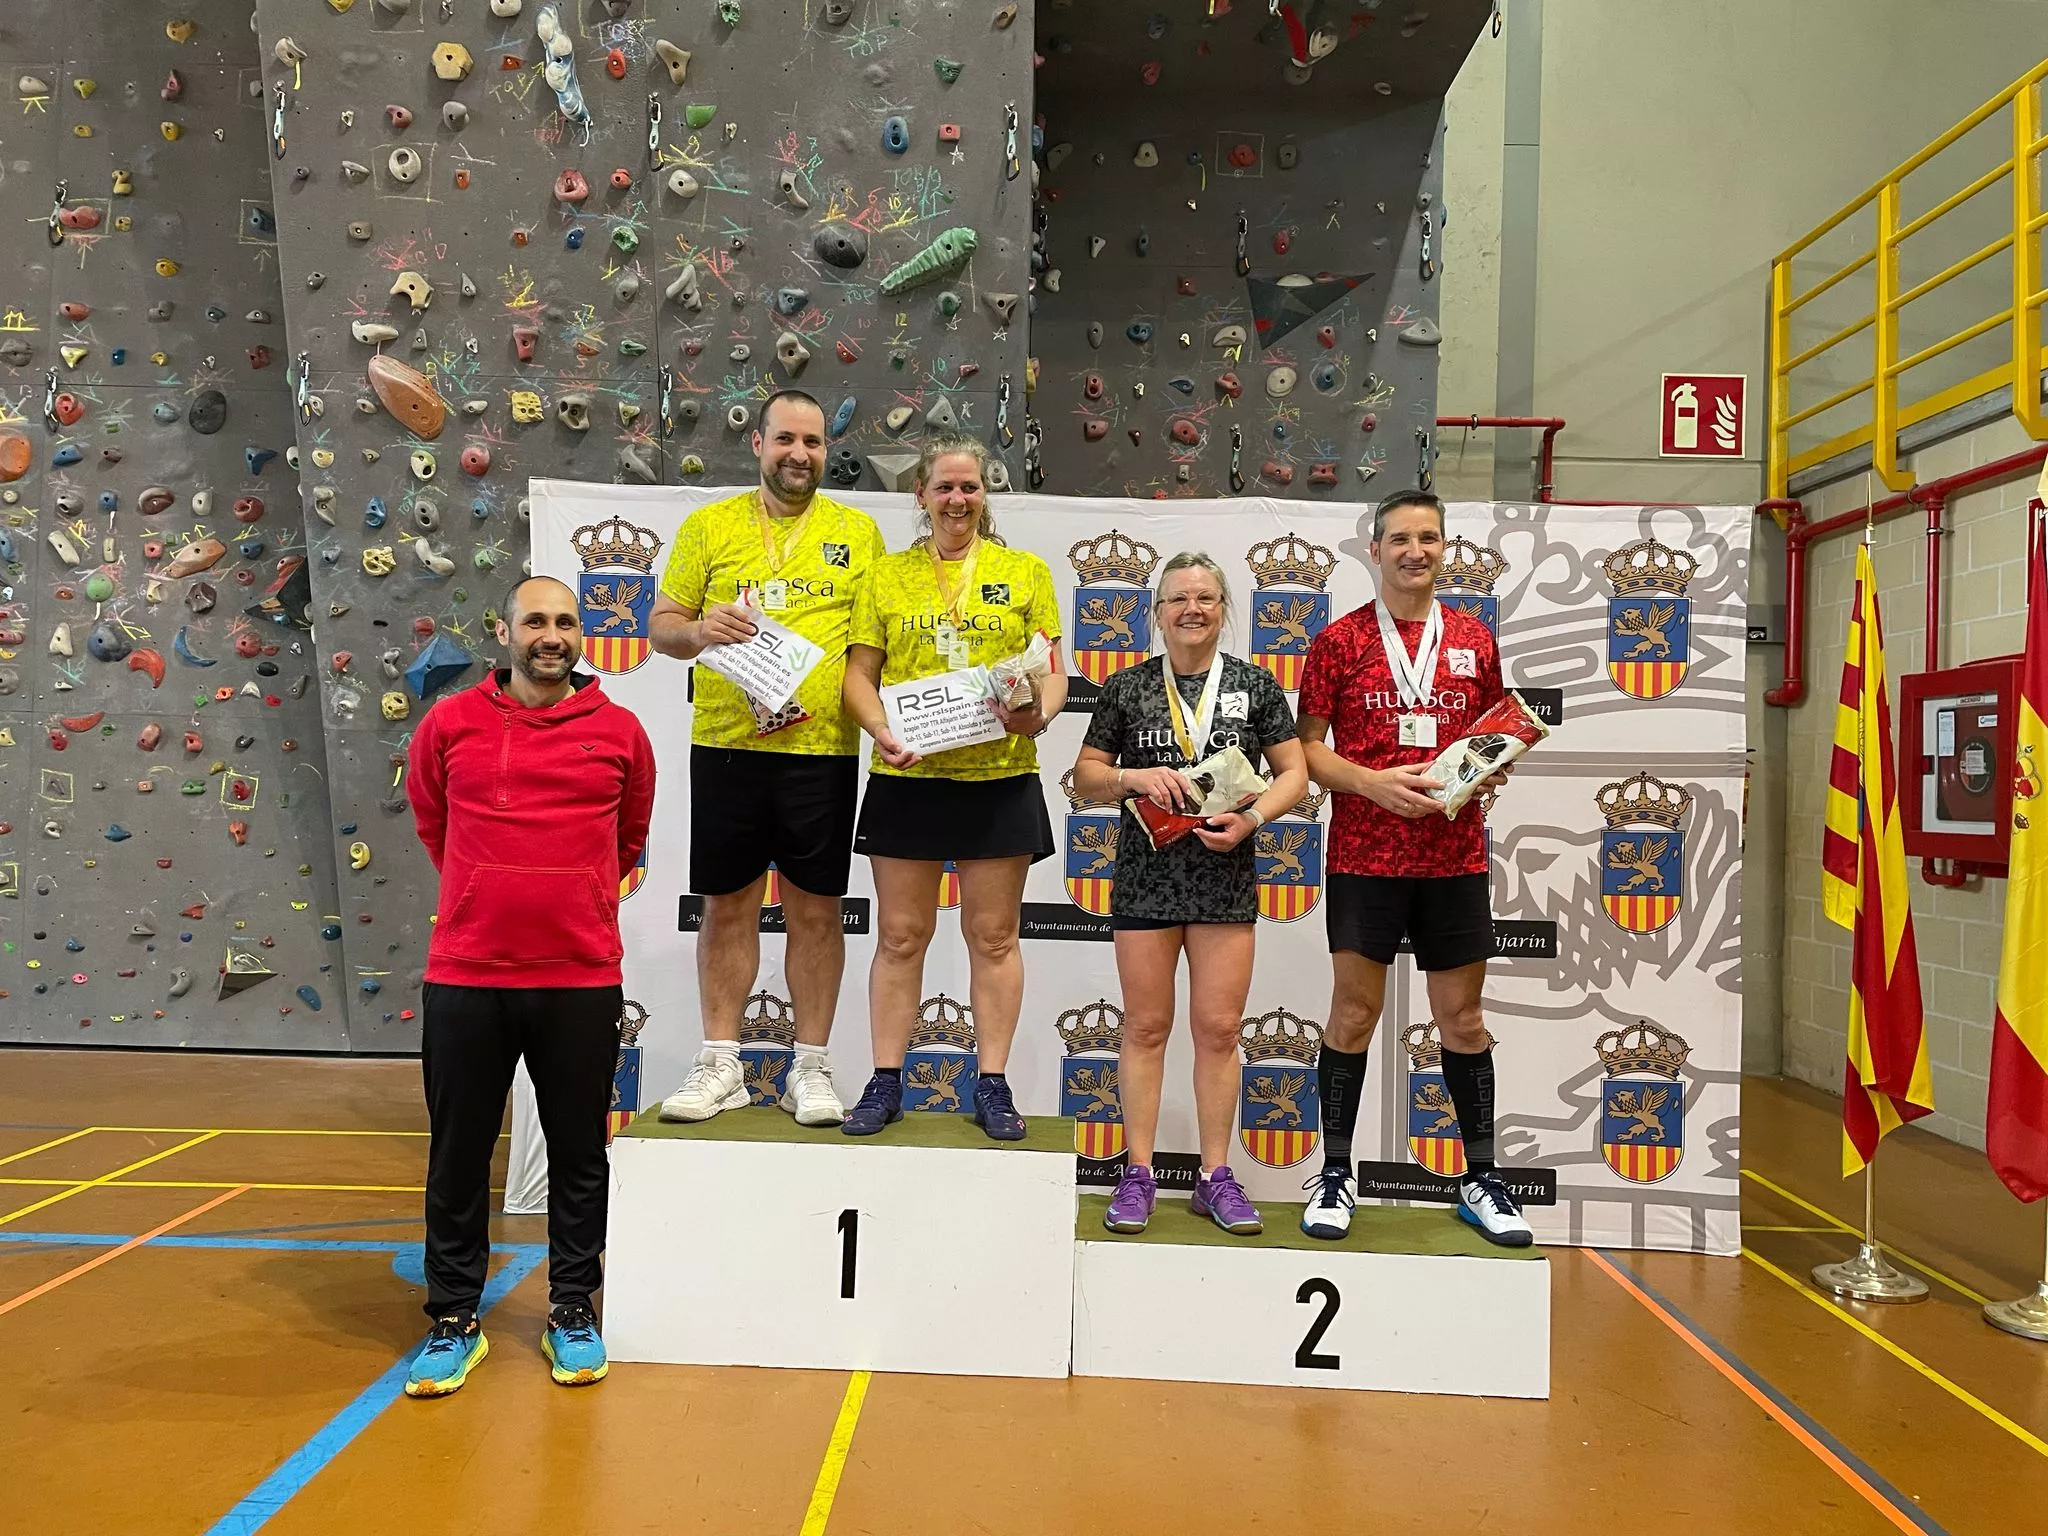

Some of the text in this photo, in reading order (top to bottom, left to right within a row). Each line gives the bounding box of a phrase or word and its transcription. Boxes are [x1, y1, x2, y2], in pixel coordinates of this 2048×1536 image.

[897, 687, 963, 714] RSL
[1024, 921, 1111, 932] Ayuntamiento de
[1093, 1167, 1105, 1177] de
[1366, 1179, 1456, 1194] Ayuntamiento de
[837, 1209, 857, 1299] 1
[1294, 1277, 1341, 1370] 2
